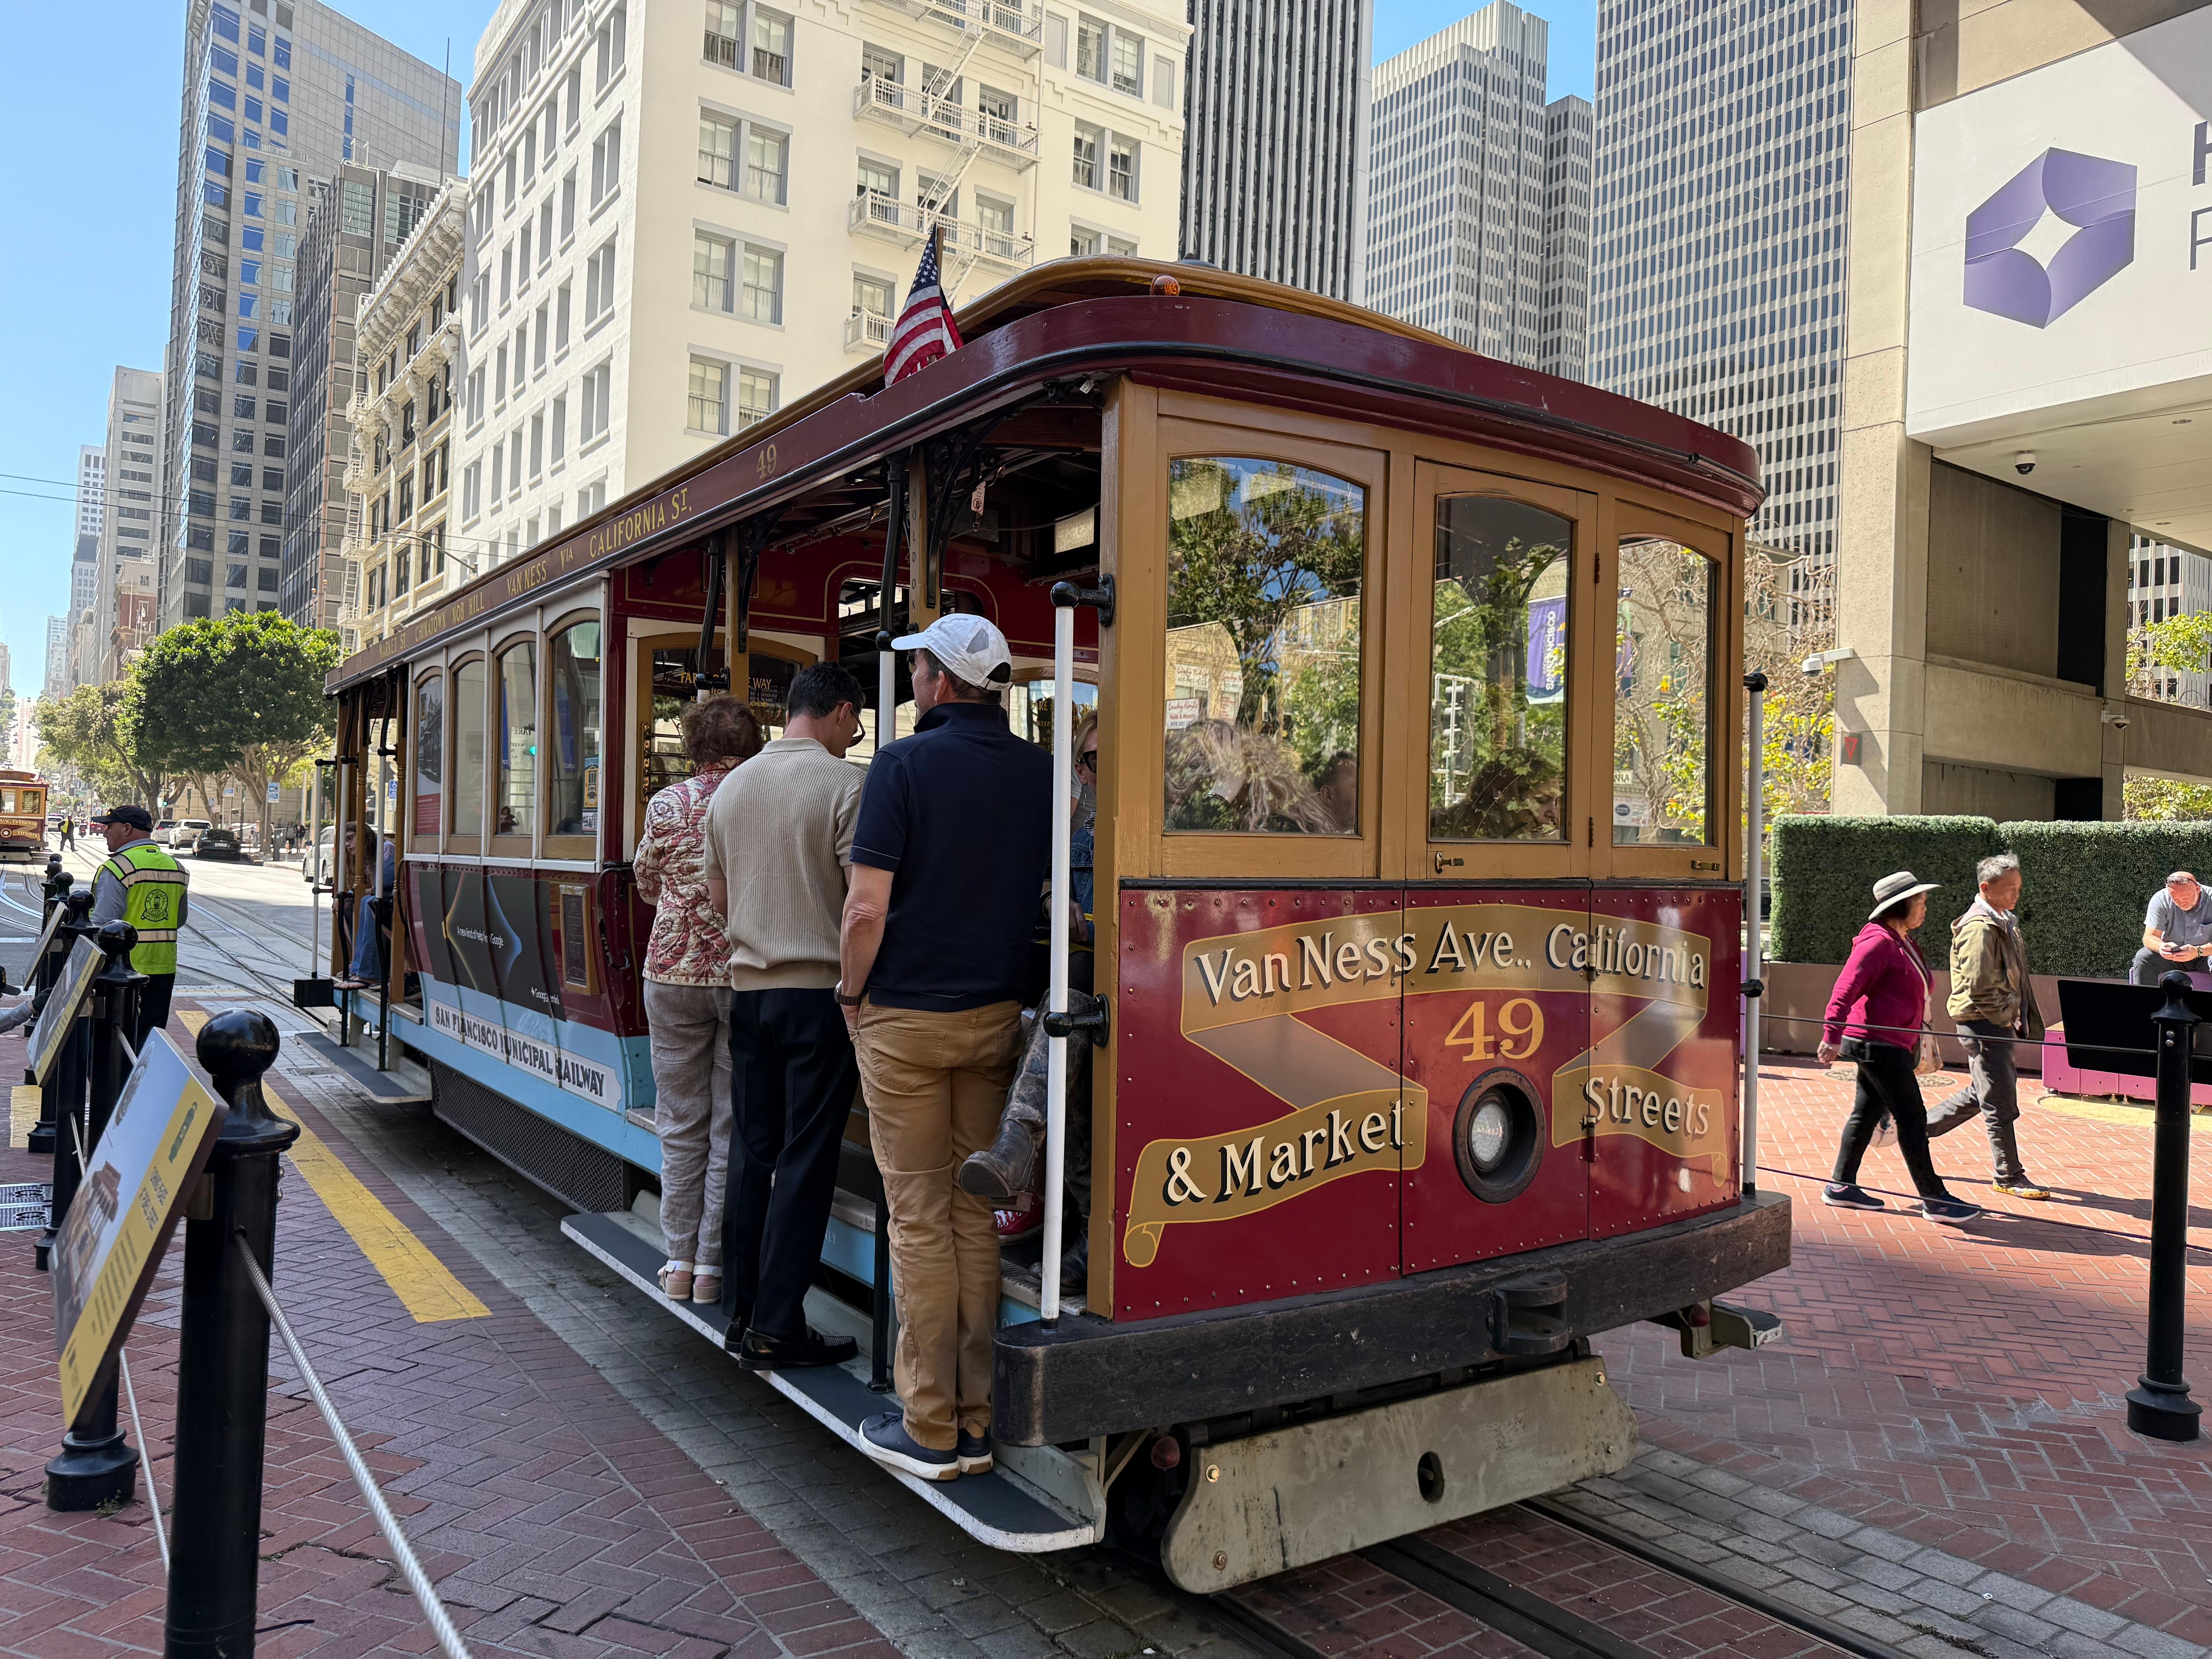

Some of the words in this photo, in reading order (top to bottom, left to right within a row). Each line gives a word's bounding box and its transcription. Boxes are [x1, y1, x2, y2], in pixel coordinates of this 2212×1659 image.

[756, 443, 777, 480] 49
[507, 571, 522, 596] VAN
[524, 561, 546, 590] NESS
[560, 547, 573, 570] VIA
[590, 501, 666, 558] CALIFORNIA
[415, 611, 446, 641] CHINATOWN
[452, 602, 464, 625] NOB
[469, 592, 484, 616] HILL
[753, 677, 772, 690] WAY
[491, 933, 504, 948] Google
[1194, 947, 1293, 1008] Van
[1295, 931, 1417, 991] Ness
[1546, 923, 1705, 989] California
[436, 1006, 450, 1029] SAN
[1444, 998, 1544, 1062] 49
[1581, 1076, 1710, 1139] Streets
[1162, 1146, 1206, 1206] &
[1214, 1099, 1406, 1203] Market
